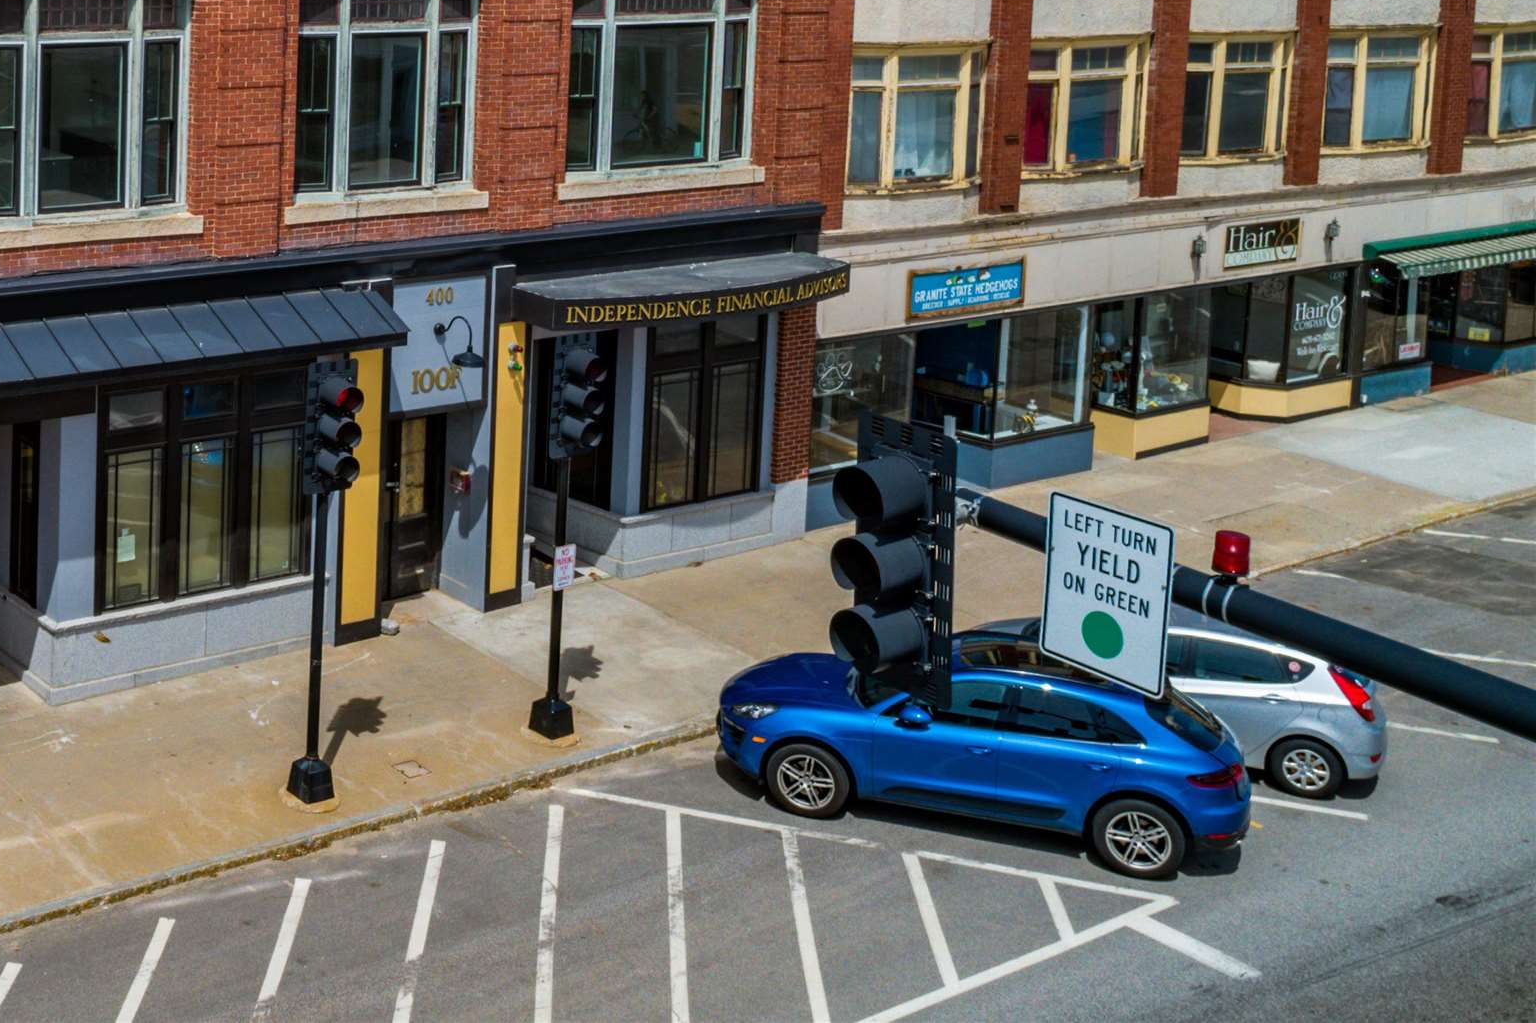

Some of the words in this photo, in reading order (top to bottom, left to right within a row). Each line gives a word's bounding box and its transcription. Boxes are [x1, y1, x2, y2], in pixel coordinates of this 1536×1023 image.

[1227, 225, 1275, 252] Hair
[426, 286, 454, 306] 400
[565, 298, 711, 324] INDEPENDENCE
[716, 286, 794, 314] FINANCIAL
[797, 272, 848, 300] ADVISORS
[914, 287, 948, 304] GRANITE
[950, 284, 973, 298] STATE
[1296, 302, 1329, 321] Hair
[411, 365, 462, 395] IOOF
[1065, 509, 1104, 538] LEFT
[1112, 524, 1157, 555] TURN
[1077, 542, 1141, 584] YIELD
[1064, 572, 1085, 595] ON
[1094, 583, 1150, 619] GREEN
